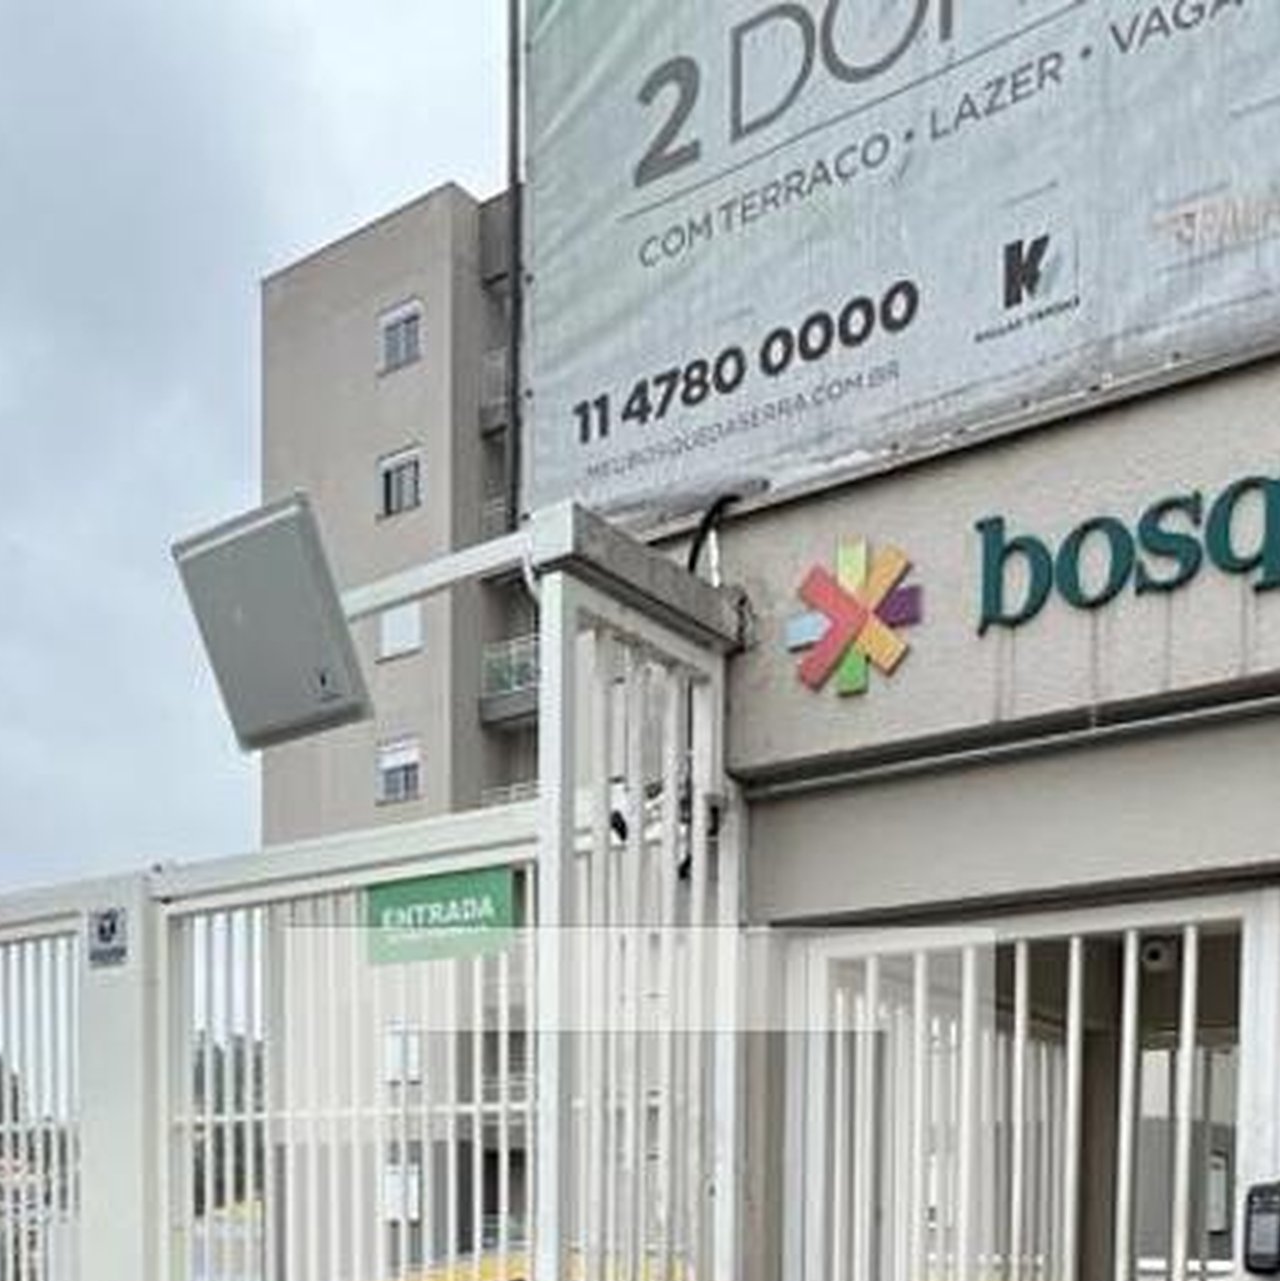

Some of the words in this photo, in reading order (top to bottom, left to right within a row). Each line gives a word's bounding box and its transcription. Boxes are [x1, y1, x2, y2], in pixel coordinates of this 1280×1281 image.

[633, 55, 701, 188] 2
[638, 212, 713, 268] COM
[719, 133, 891, 232] TERRAÇO
[930, 51, 1066, 140] LAZER
[1004, 233, 1050, 310] K
[573, 394, 609, 444] 11
[621, 346, 746, 425] 4780
[759, 279, 919, 376] 0000
[381, 895, 495, 930] ENTRADA
